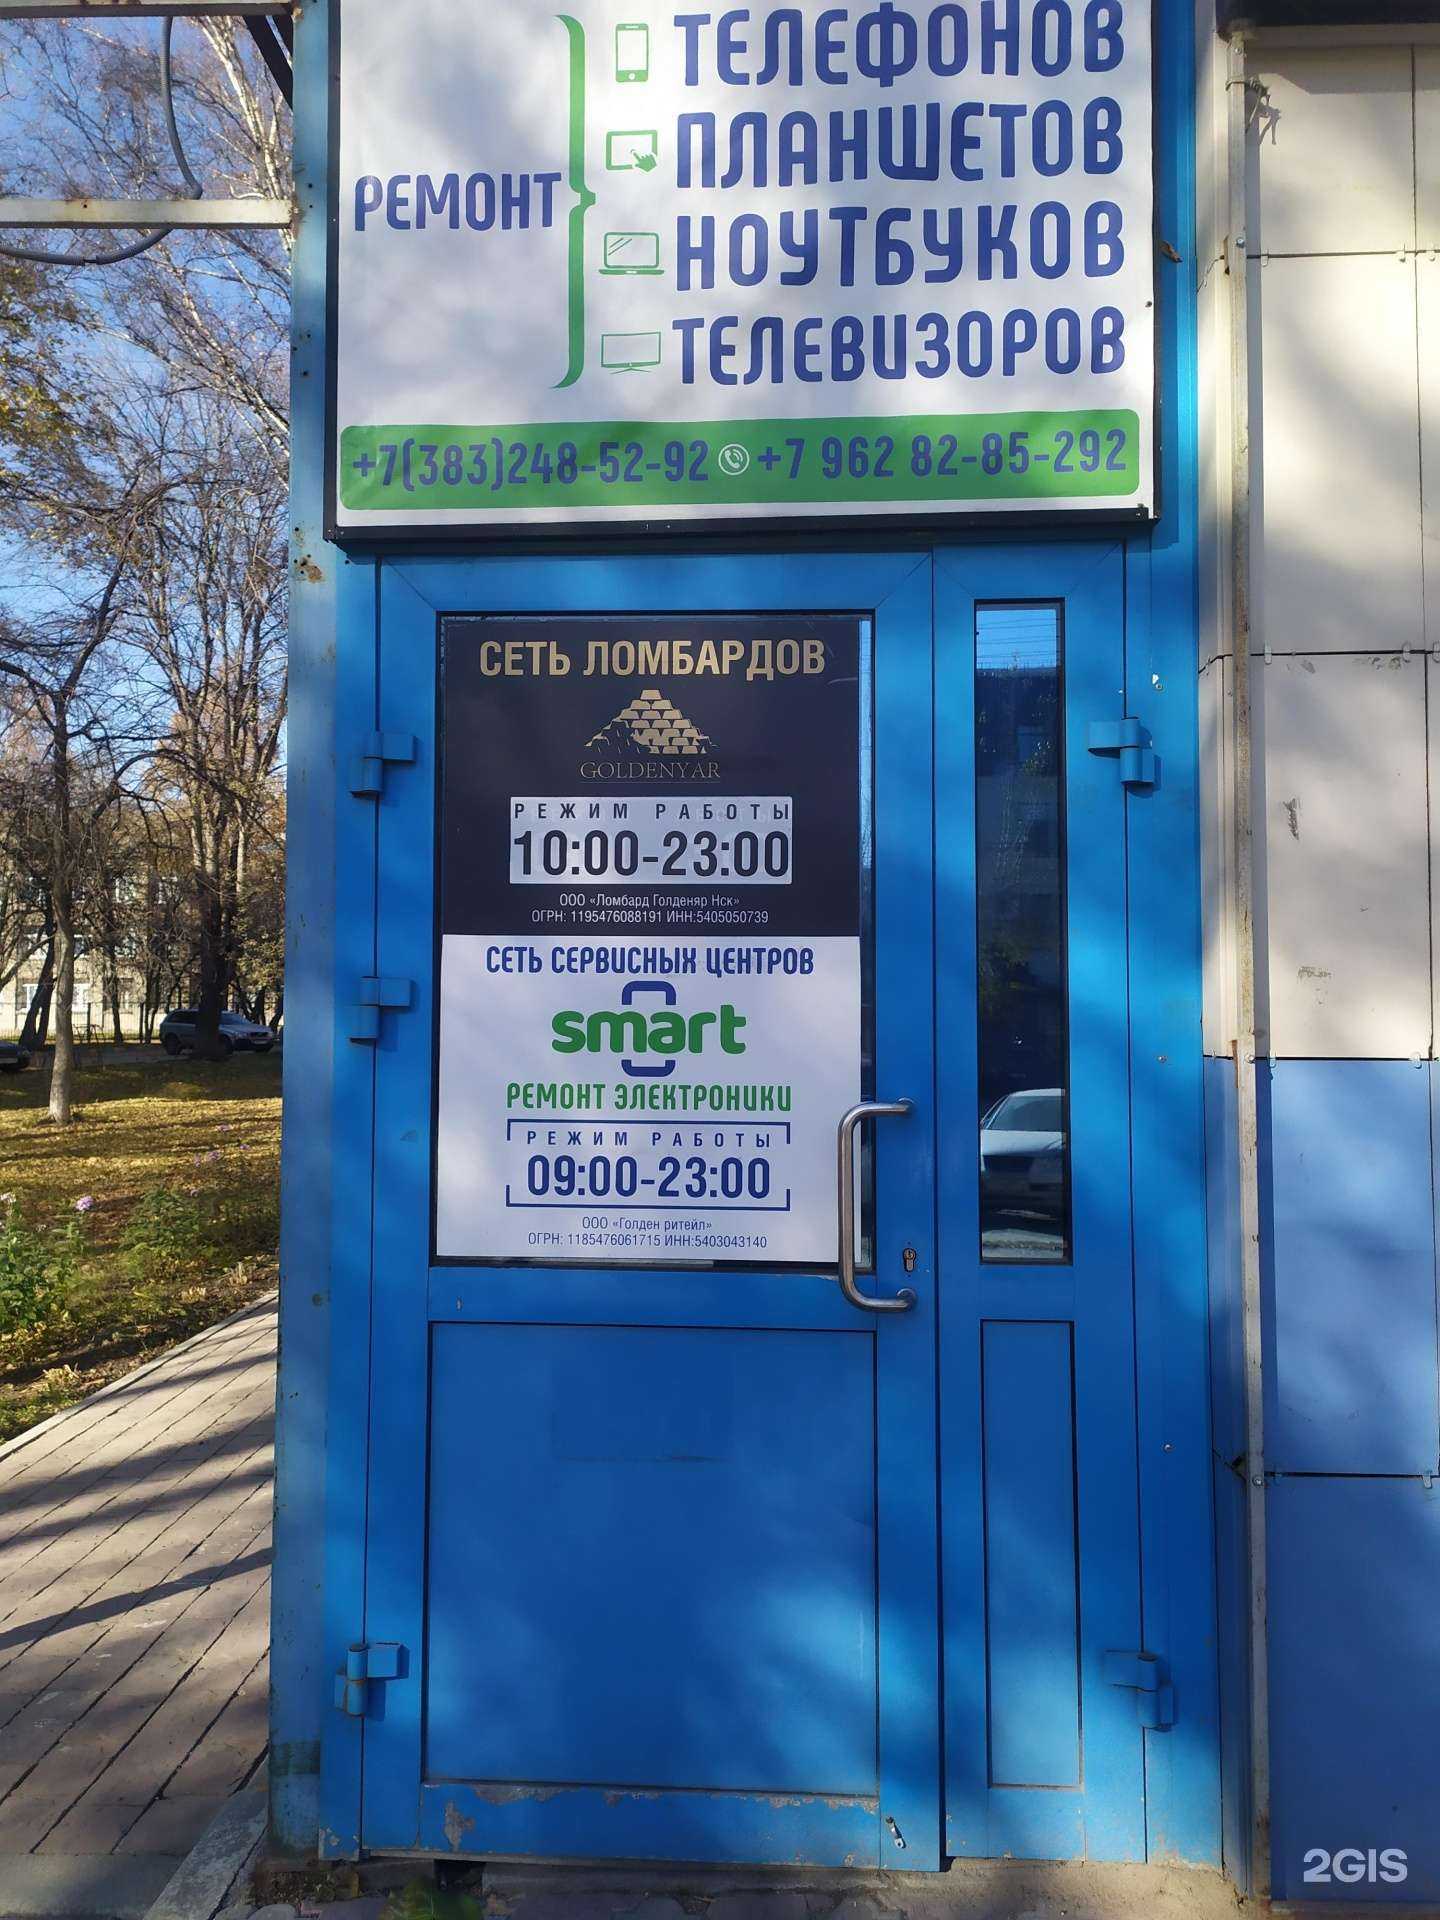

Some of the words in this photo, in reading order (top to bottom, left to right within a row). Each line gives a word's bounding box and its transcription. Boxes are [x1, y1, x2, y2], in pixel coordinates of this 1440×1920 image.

[674, 0, 1125, 87] ТЕЛЕФОНОВ
[676, 96, 1124, 189] ПЛАНШЕТОВ
[354, 171, 561, 232] РЕМОНТ
[675, 201, 1124, 291] НОУТБУКОВ
[672, 306, 1125, 389] ТЕЛЕВИЗОРОВ
[352, 439, 710, 490] +7(383)248-52-92
[757, 437, 802, 477] +7
[822, 435, 894, 477] 962
[911, 429, 1127, 476] 82-85-292
[480, 640, 571, 676] СЕТЬ
[583, 639, 825, 681] ЛОМБАРДОВ
[579, 761, 721, 780] GOLDENYAR
[514, 803, 629, 820] РЕЖИМ
[655, 803, 790, 820] РАБОТЫ
[513, 830, 790, 877] 10:00-23:00
[531, 910, 567, 923] ОГРН:
[570, 910, 663, 924] 1195476088191
[559, 893, 586, 907] ООО
[589, 894, 649, 909] «Ломбард
[653, 894, 709, 909] Голденяр
[712, 894, 740, 908] Нск»
[486, 945, 542, 974] СЕТЬ
[551, 946, 697, 975] СЕРВИСНЫХ
[706, 947, 815, 978] ЦЕНТРОВ
[551, 1004, 747, 1055] smart
[506, 1082, 606, 1110] РЕМОНТ
[614, 1083, 792, 1112] ЭЛЕКТРОНИКИ
[527, 1130, 629, 1146] РЕЖИМ
[652, 1131, 771, 1148] РАБОТЫ
[527, 1154, 771, 1199] 09:00-23:00
[528, 1232, 564, 1246] ОГРН:
[567, 1233, 661, 1247] 1185476061715
[582, 1216, 608, 1230] ООО
[612, 1217, 661, 1232] «Голден
[664, 1217, 712, 1232] ритейл»
